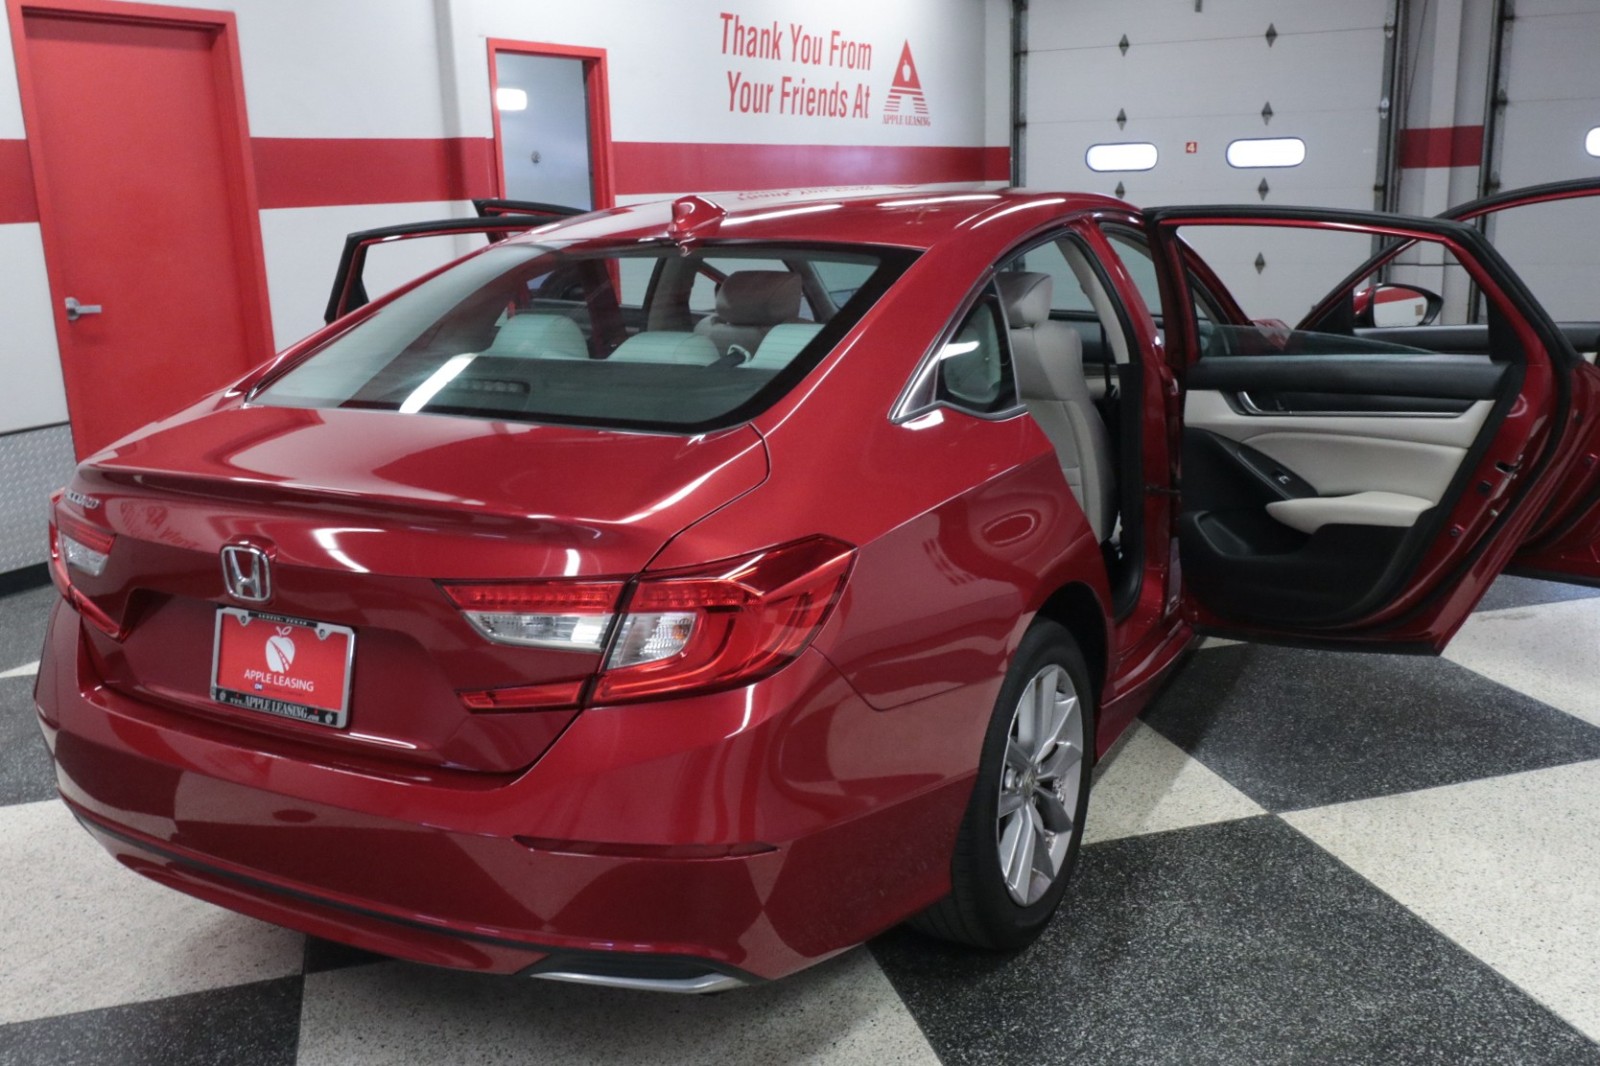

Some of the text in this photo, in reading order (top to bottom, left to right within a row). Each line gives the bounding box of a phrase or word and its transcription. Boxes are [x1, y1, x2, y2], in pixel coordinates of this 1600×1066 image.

[719, 12, 872, 71] Thank You From
[727, 71, 870, 119] Your Friends At
[882, 114, 931, 127] APPLE LEASING
[244, 668, 272, 684] APPLE
[273, 675, 314, 692] LEASING
